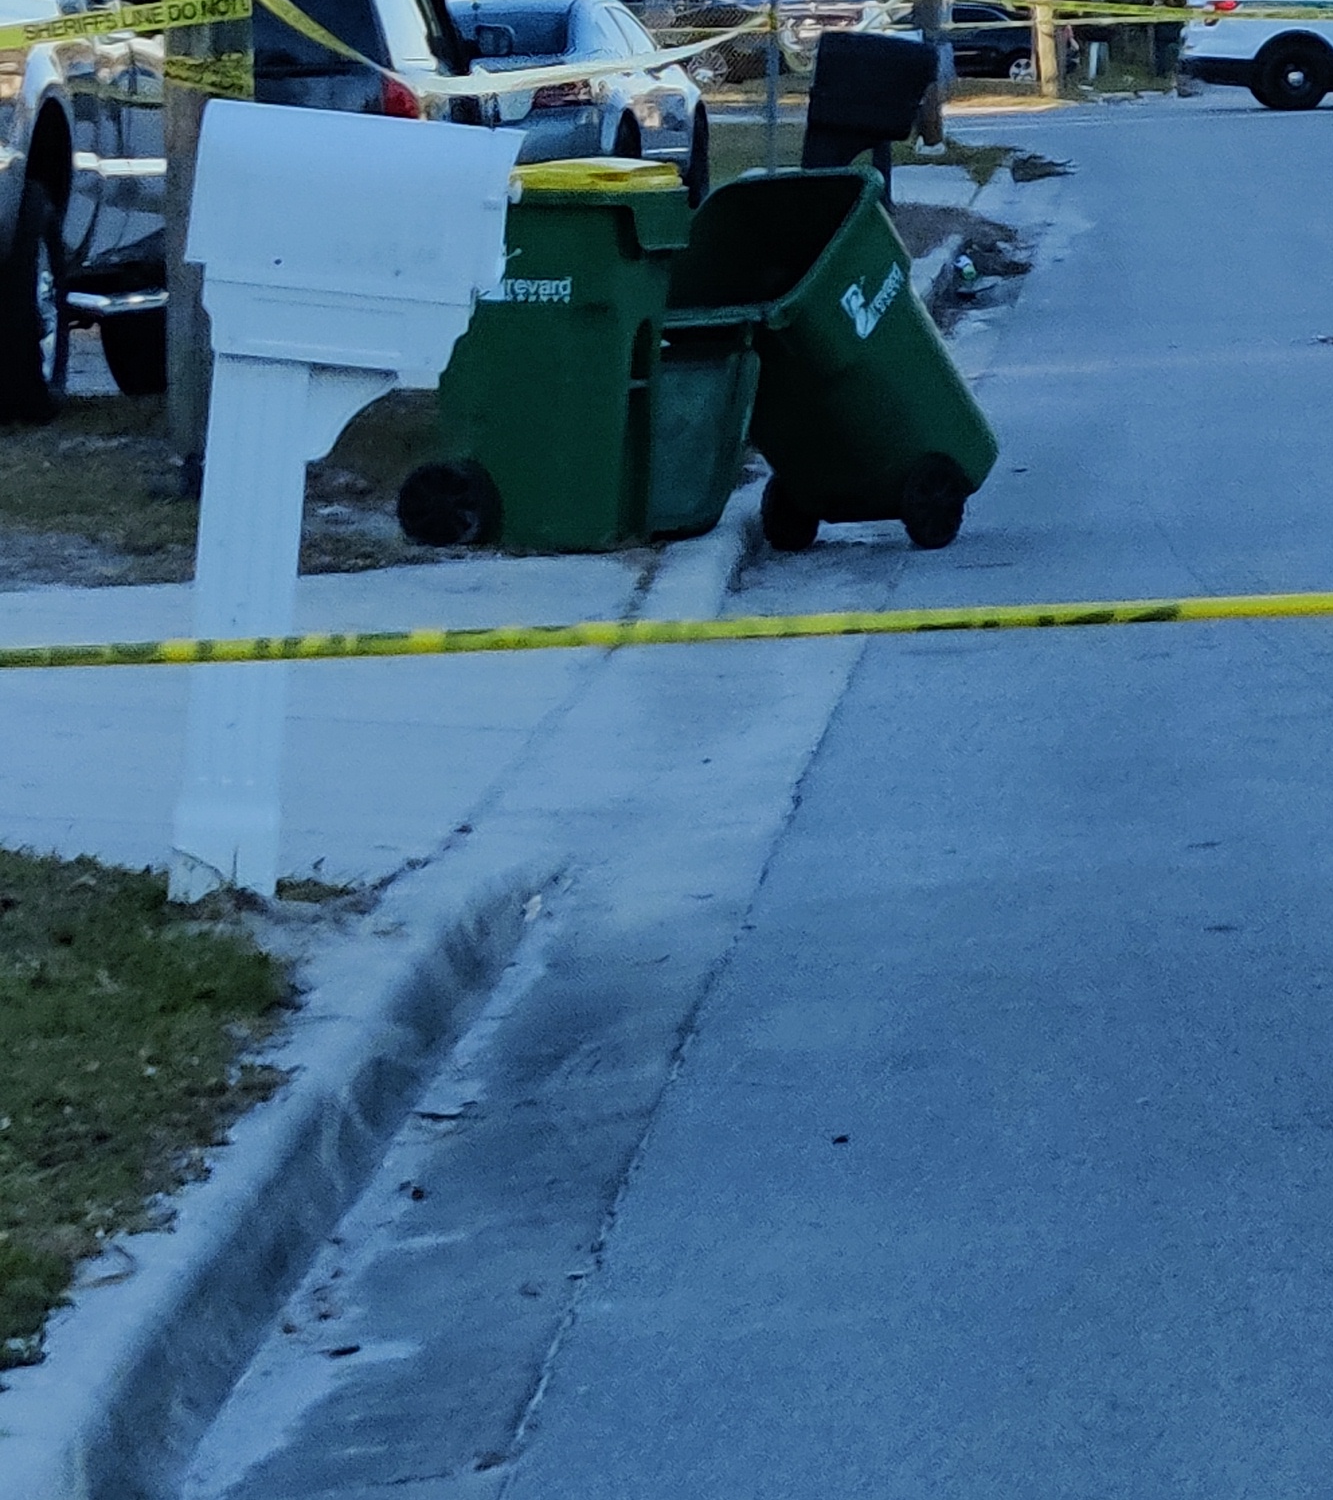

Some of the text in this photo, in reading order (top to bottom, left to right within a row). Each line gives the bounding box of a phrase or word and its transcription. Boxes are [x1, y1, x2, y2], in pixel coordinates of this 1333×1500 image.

[121, 7, 165, 28] LINE
[168, 0, 197, 22] DO
[504, 276, 573, 295] revard
